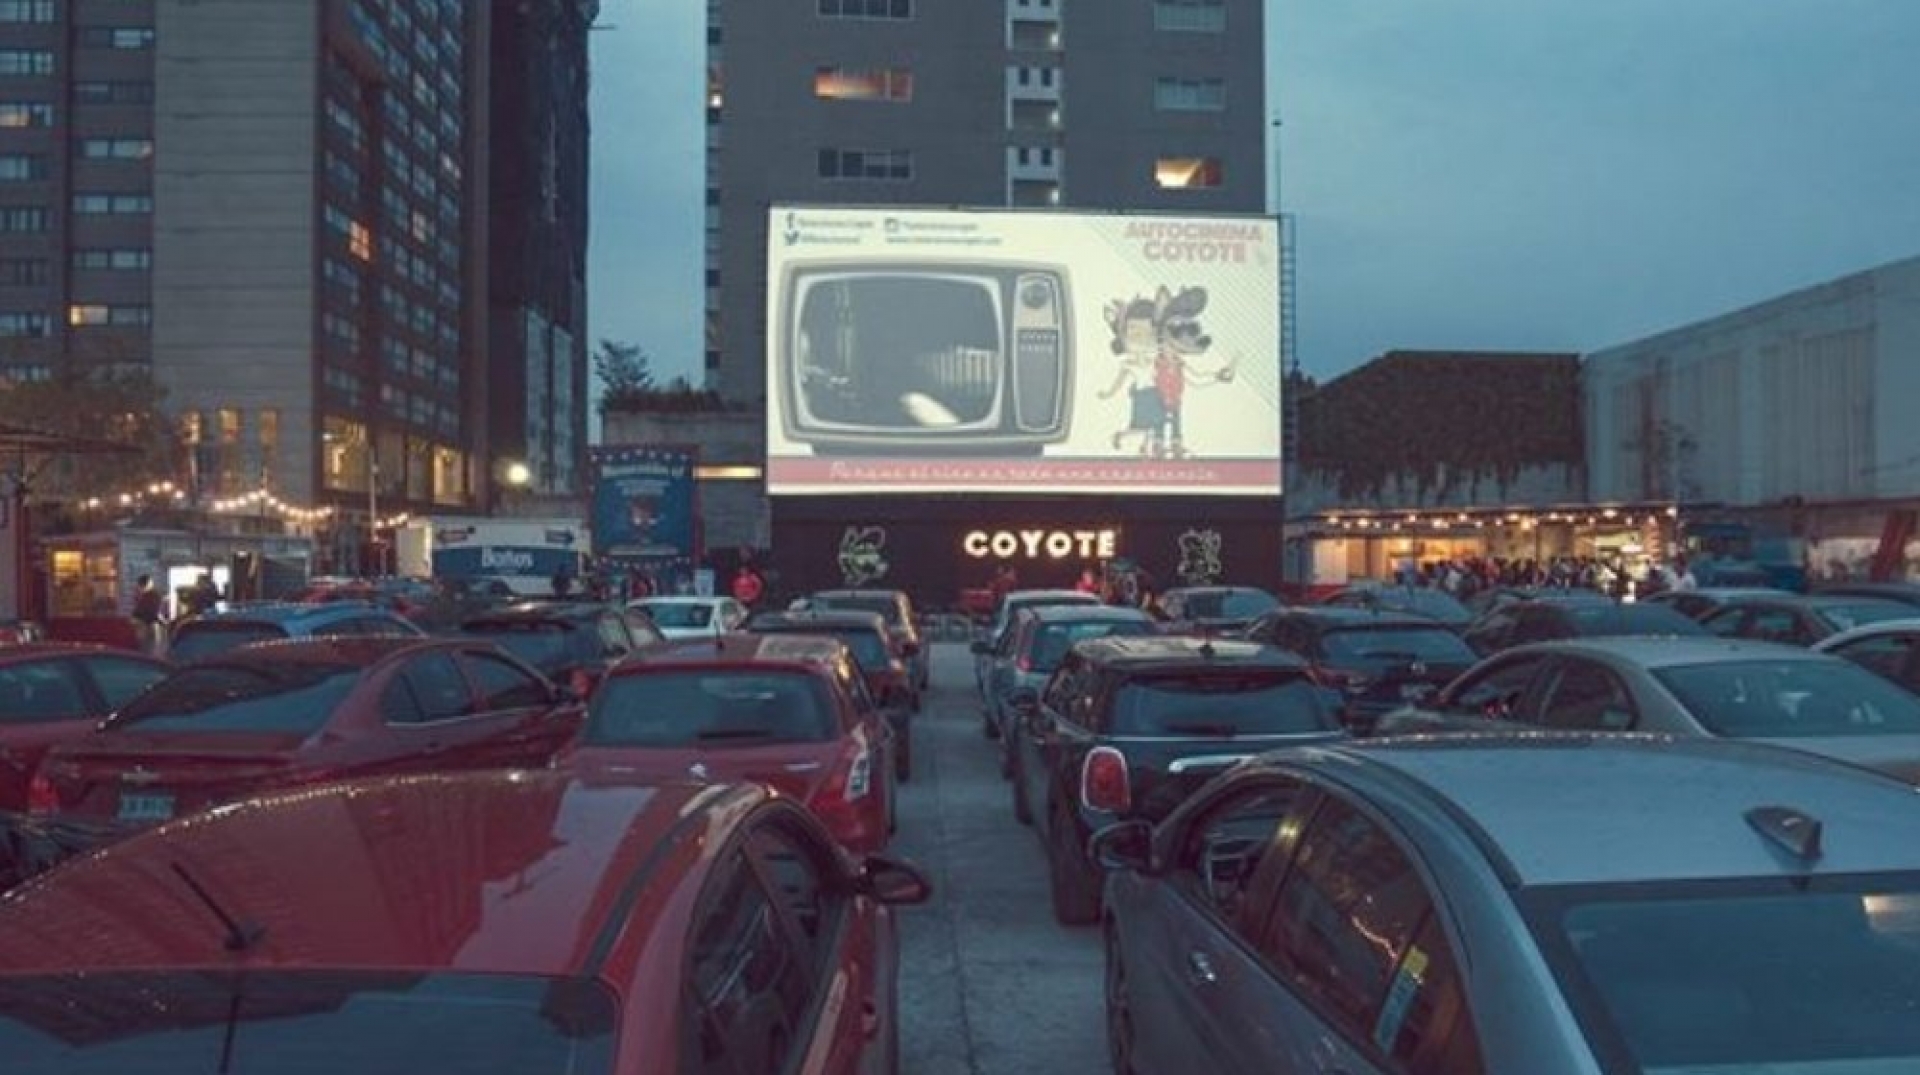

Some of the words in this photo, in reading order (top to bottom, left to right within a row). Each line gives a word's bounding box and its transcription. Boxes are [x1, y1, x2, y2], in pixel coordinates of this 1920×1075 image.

[1125, 221, 1263, 240] AUTOCINEMA
[1143, 240, 1245, 262] COYOTE
[964, 530, 1116, 558] COYOTE
